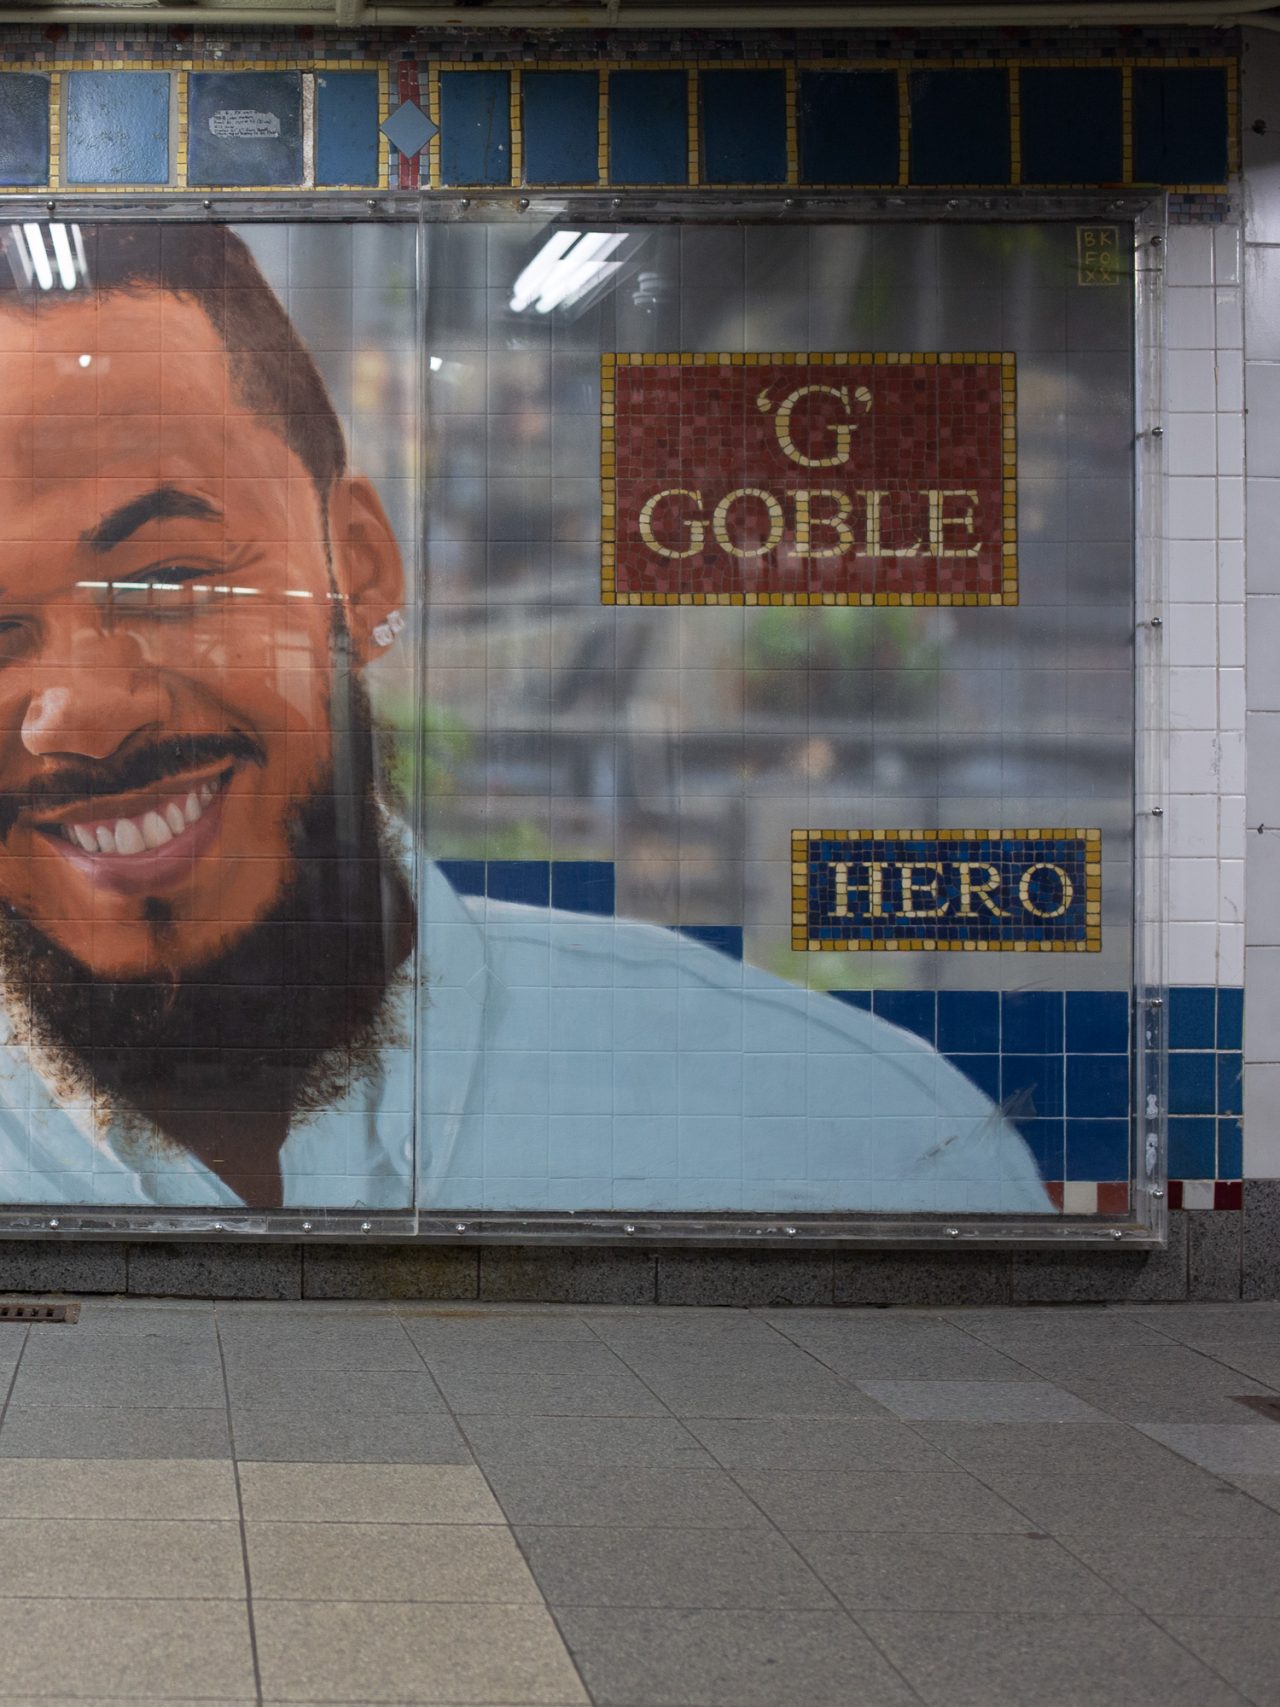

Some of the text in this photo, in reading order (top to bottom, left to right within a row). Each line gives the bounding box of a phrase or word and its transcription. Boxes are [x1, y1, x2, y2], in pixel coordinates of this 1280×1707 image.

[1084, 231, 1112, 247] BK
[639, 487, 982, 559] GOBLE
[827, 861, 1074, 918] HERO
